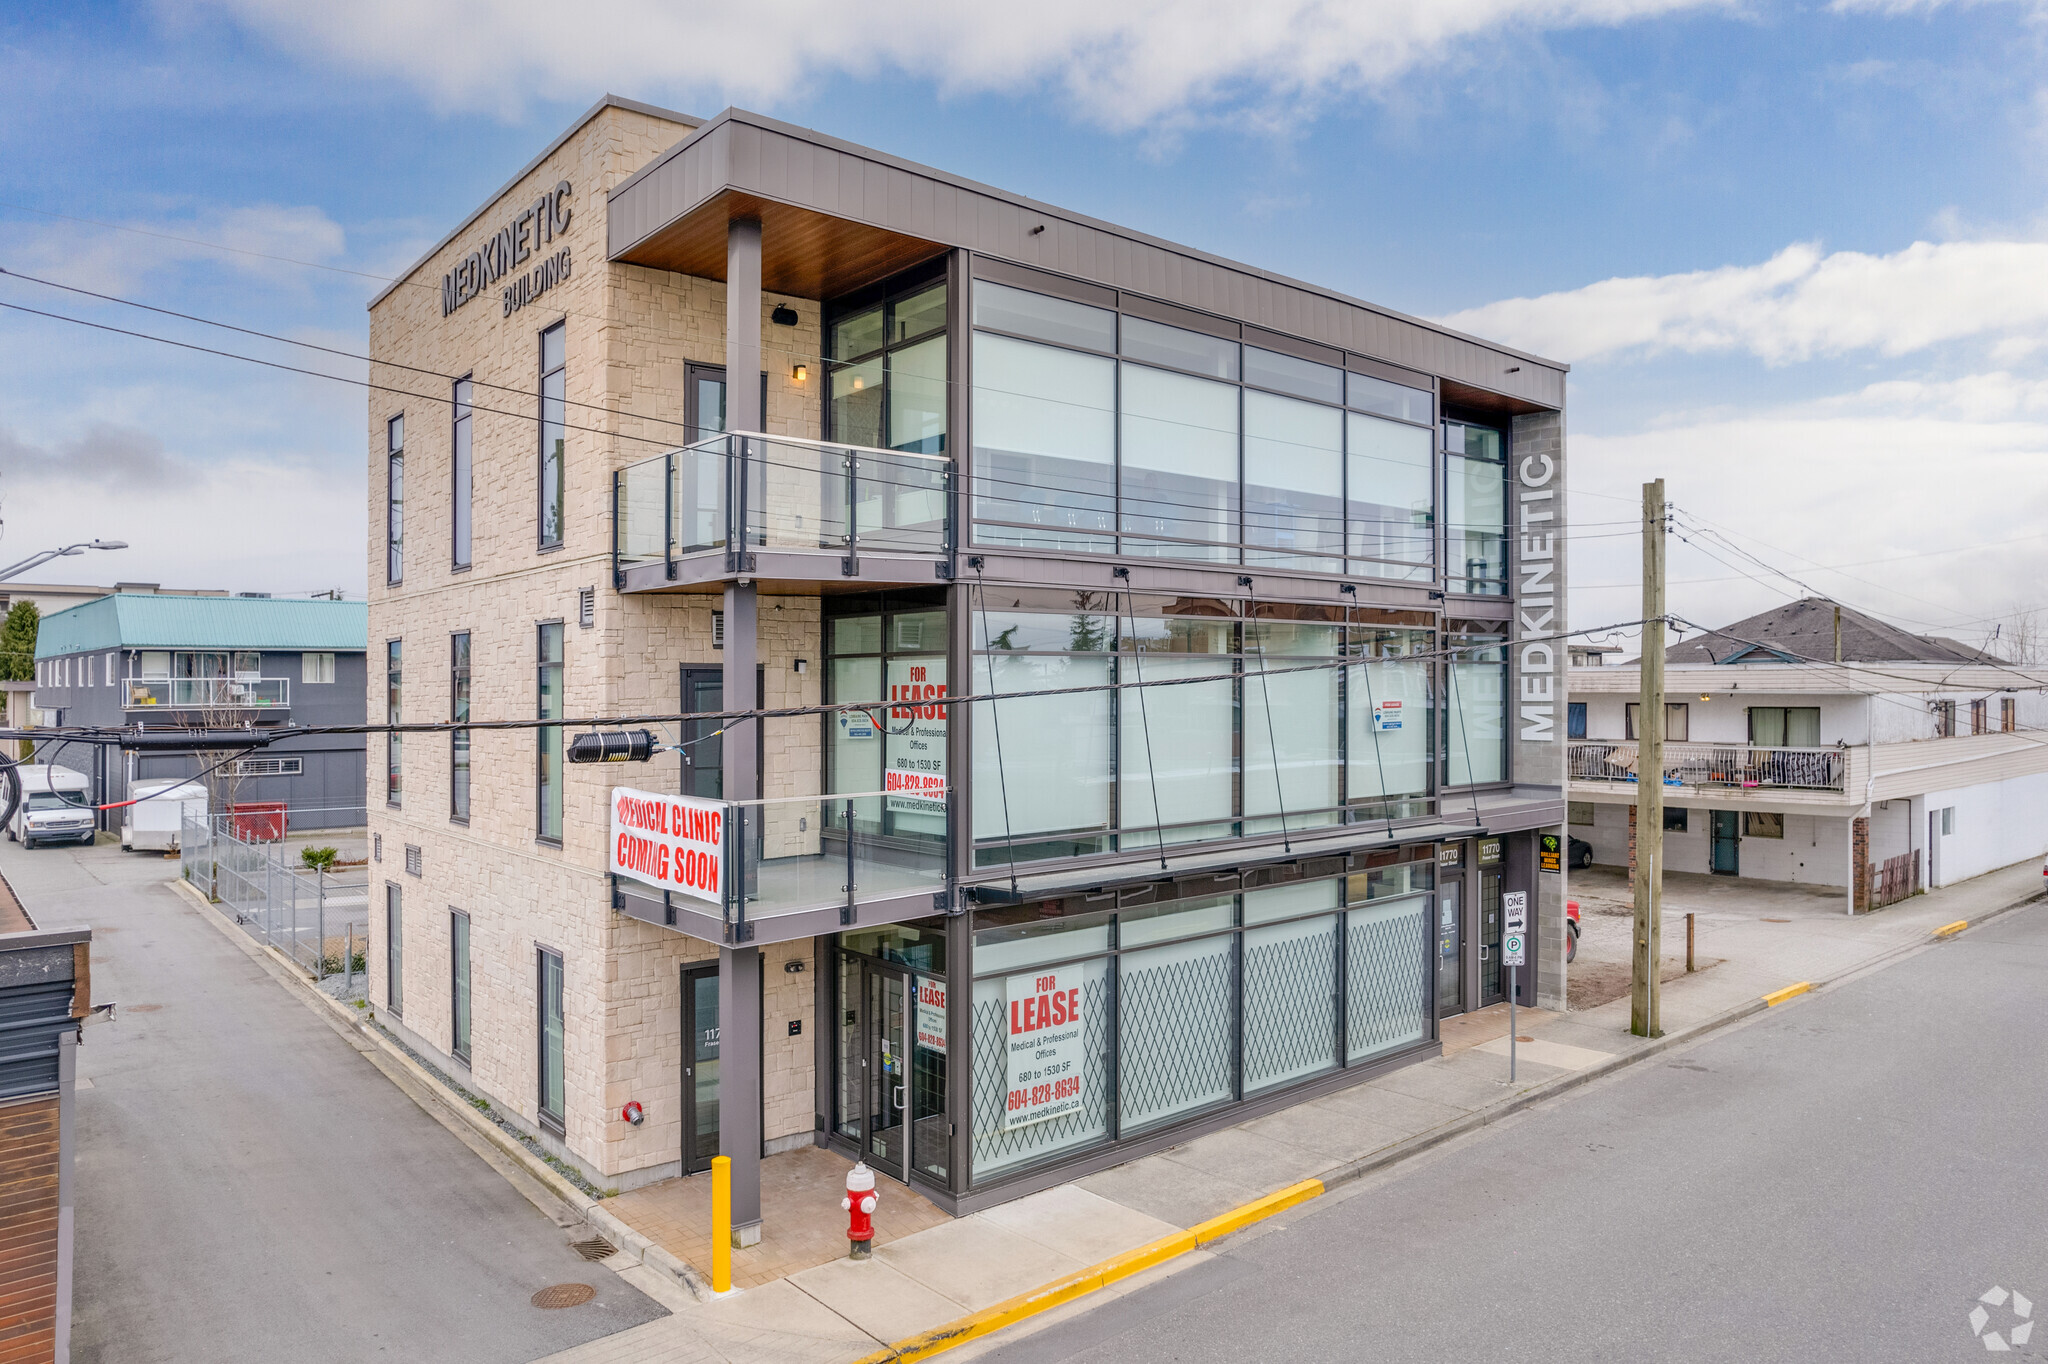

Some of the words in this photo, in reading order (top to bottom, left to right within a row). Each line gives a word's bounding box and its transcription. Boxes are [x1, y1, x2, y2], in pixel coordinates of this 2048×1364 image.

[442, 180, 572, 317] MEDKINETIC
[503, 246, 571, 318] BUILDING
[1520, 454, 1554, 741] MEDKINETIC
[910, 666, 926, 682] FOR
[892, 684, 947, 720] LEASE
[892, 726, 909, 736] Medical
[911, 727, 915, 736] &
[910, 740, 927, 750] Offices
[897, 758, 907, 768] 680
[909, 759, 915, 769] to
[917, 760, 931, 770] 1530
[933, 760, 941, 771] SF
[617, 795, 668, 834] MEDICAL
[672, 804, 721, 846] CLINIC
[1482, 842, 1500, 854] 11770
[617, 833, 669, 880] COMING
[674, 847, 718, 893] SOON
[1507, 896, 1524, 907] ONE
[1508, 907, 1523, 917] WAY
[1511, 940, 1518, 948] P
[1036, 976, 1056, 993] FOR
[919, 986, 945, 1009] LEASE
[1011, 988, 1079, 1035] LEASE
[1011, 1038, 1035, 1052] Medical
[1036, 1038, 1042, 1047] &
[1043, 1029, 1079, 1044] Professional
[1035, 1047, 1056, 1060] Offices
[1019, 1071, 1032, 1083] 680
[1034, 1069, 1041, 1079] to
[1044, 1063, 1060, 1077] 1530
[1062, 1061, 1071, 1072] SF
[1008, 1076, 1080, 1111] 604-828-8634
[1010, 1101, 1080, 1126] www.medkinetic.ca
